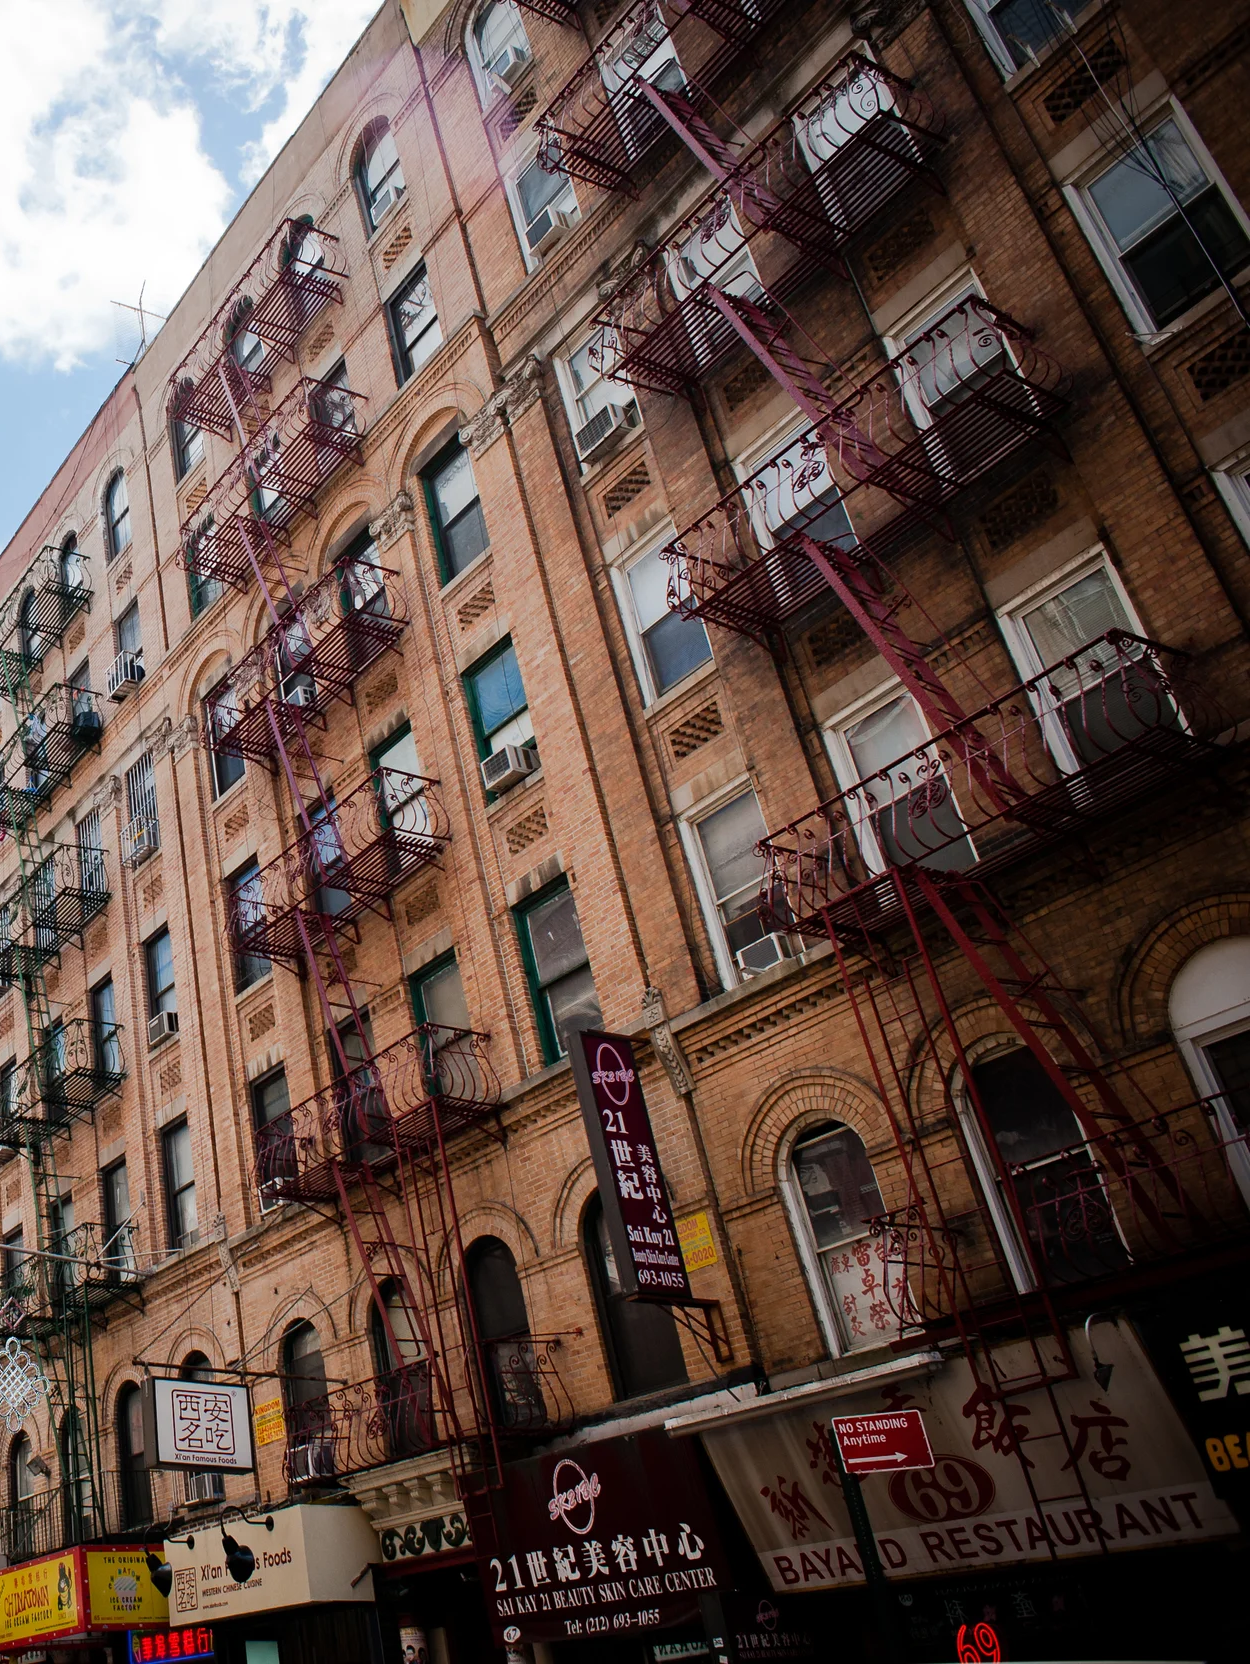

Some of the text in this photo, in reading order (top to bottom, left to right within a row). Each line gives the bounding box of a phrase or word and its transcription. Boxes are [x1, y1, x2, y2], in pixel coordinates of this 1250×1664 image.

[636, 1144, 668, 1224] 美容中心
[663, 1229, 675, 1246] 21
[677, 1218, 698, 1235] GDOM
[638, 1268, 685, 1288] 693-1055
[176, 1394, 230, 1422] 西安
[178, 1421, 232, 1451] 名吃
[838, 1417, 908, 1434] NO STANDING
[843, 1433, 887, 1448] Anytime
[1205, 1431, 1250, 1472] BE
[174, 1453, 238, 1465] Xi'an Famous Foods
[904, 1459, 980, 1521] 69
[773, 1493, 1205, 1585] BAYAD RESTAURANT
[104, 1556, 146, 1564] THE ORIGINA
[200, 1563, 222, 1581] Xi'an
[263, 1547, 292, 1568] Foods
[489, 1523, 705, 1592] 21世紀美容中心
[202, 1578, 263, 1597] WESTERN CHINESE CUISINE
[496, 1567, 718, 1617] SAI KAY 21 BEAUTY SKIN CARE CENTER
[4, 1585, 50, 1618] CHINATOWN
[110, 1596, 143, 1604] ICE CREAM
[113, 1604, 141, 1612] FACTORY
[5, 1618, 13, 1629] ICE
[14, 1616, 30, 1628] CREAM
[32, 1609, 53, 1622] FACTORY
[564, 1608, 660, 1635] Tel: (212) 693-1055
[505, 1628, 517, 1641] 67
[955, 1622, 1001, 1663] 69
